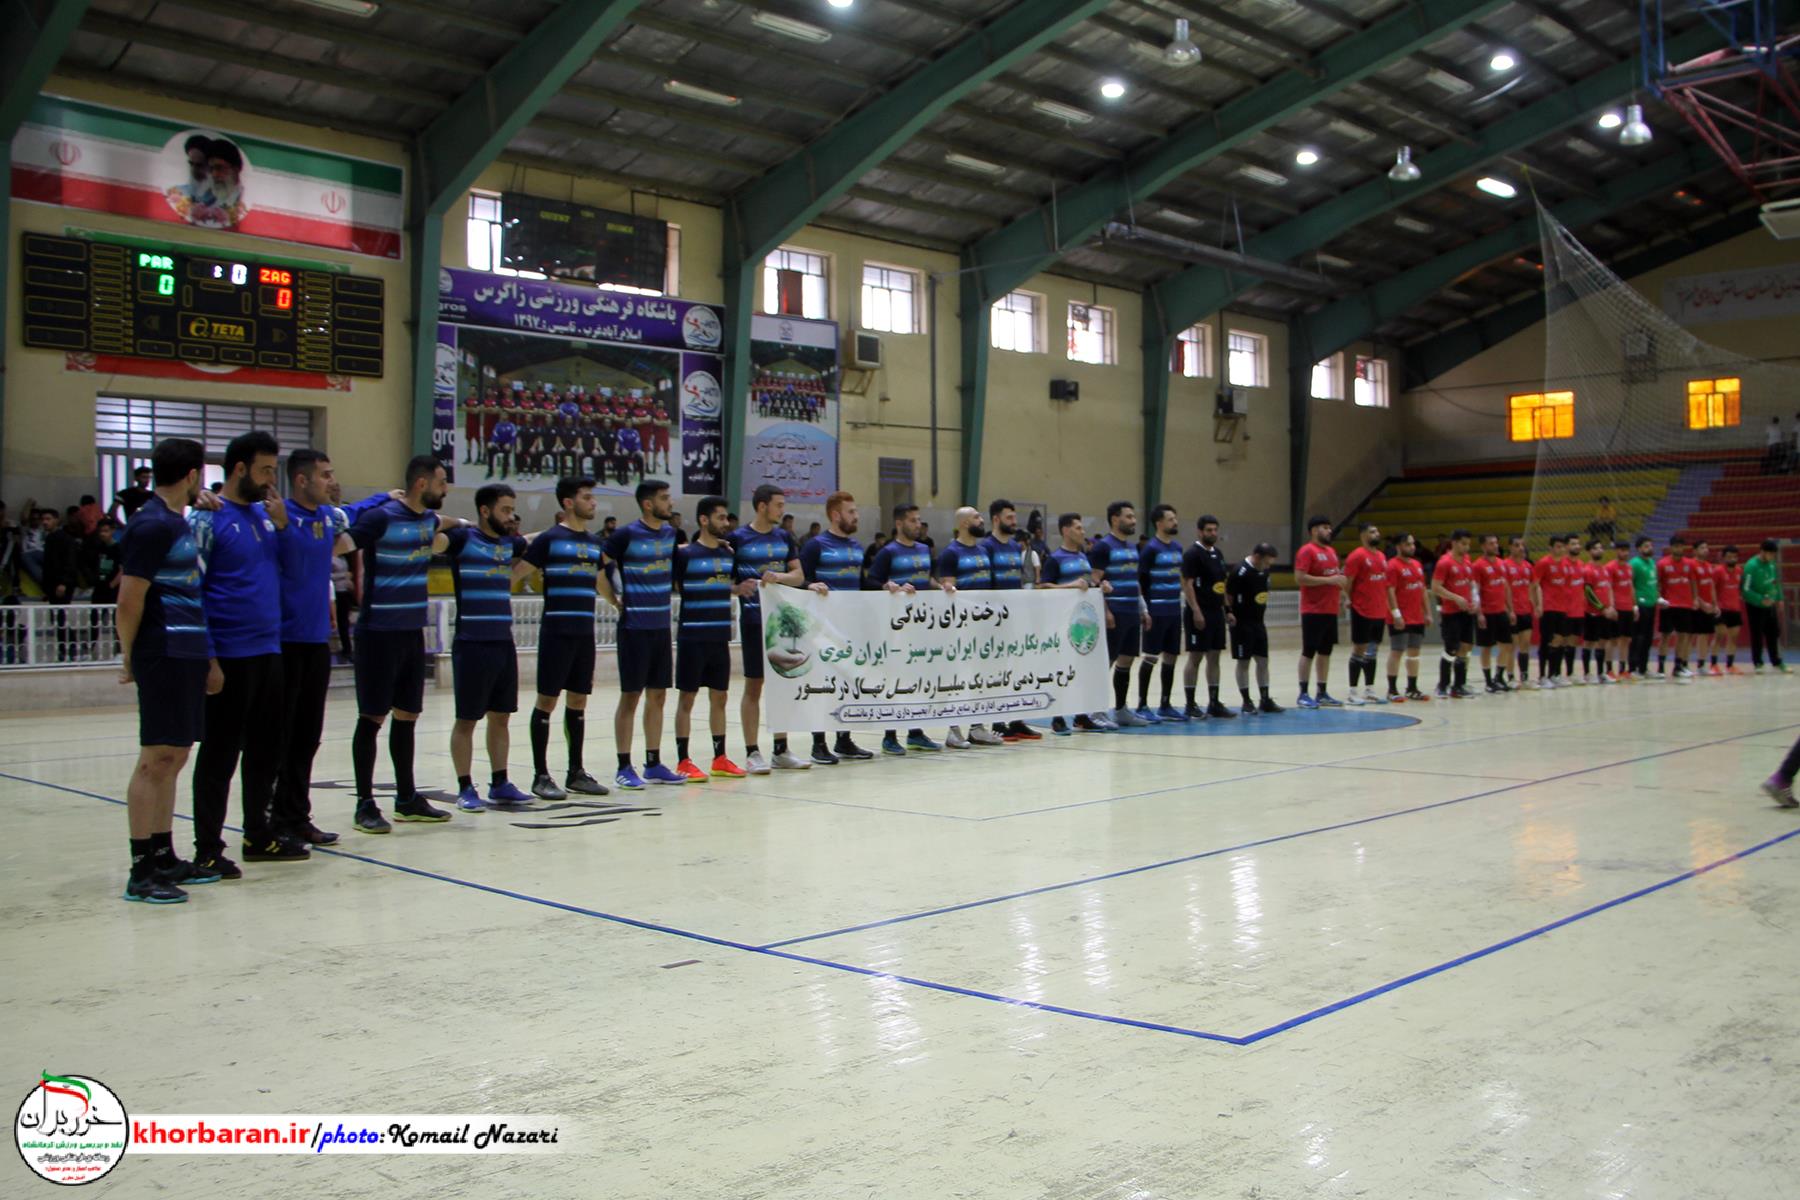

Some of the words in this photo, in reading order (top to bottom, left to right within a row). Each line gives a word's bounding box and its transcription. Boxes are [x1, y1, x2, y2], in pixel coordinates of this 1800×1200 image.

[139, 253, 174, 270] PAR
[158, 274, 175, 295] 0
[260, 267, 292, 286] ZAG
[277, 288, 293, 309] 0
[474, 281, 526, 308] زاگرس
[529, 287, 579, 316] ورزشی
[582, 296, 634, 321] فرهنگی
[637, 300, 677, 325] باشگاه
[212, 322, 245, 336] TETA
[683, 442, 720, 469] زاگرس
[890, 602, 935, 630] زندگی
[939, 601, 968, 630] برای
[971, 604, 1009, 628] درخت
[818, 640, 852, 662] قوی
[854, 640, 887, 666] ایران
[906, 643, 943, 664] سرسبز
[946, 635, 976, 662] ایران
[979, 636, 1004, 659] برای
[1007, 634, 1038, 657] بکاریم
[795, 675, 837, 700] کشور
[886, 677, 922, 699] اصل
[924, 674, 966, 700] میلیارد
[968, 671, 983, 695] یک
[986, 670, 1013, 689] کاشت
[1013, 672, 1053, 691] مردمی
[1056, 665, 1076, 688] طرح
[838, 683, 849, 701] در
[853, 677, 886, 700] نهال
